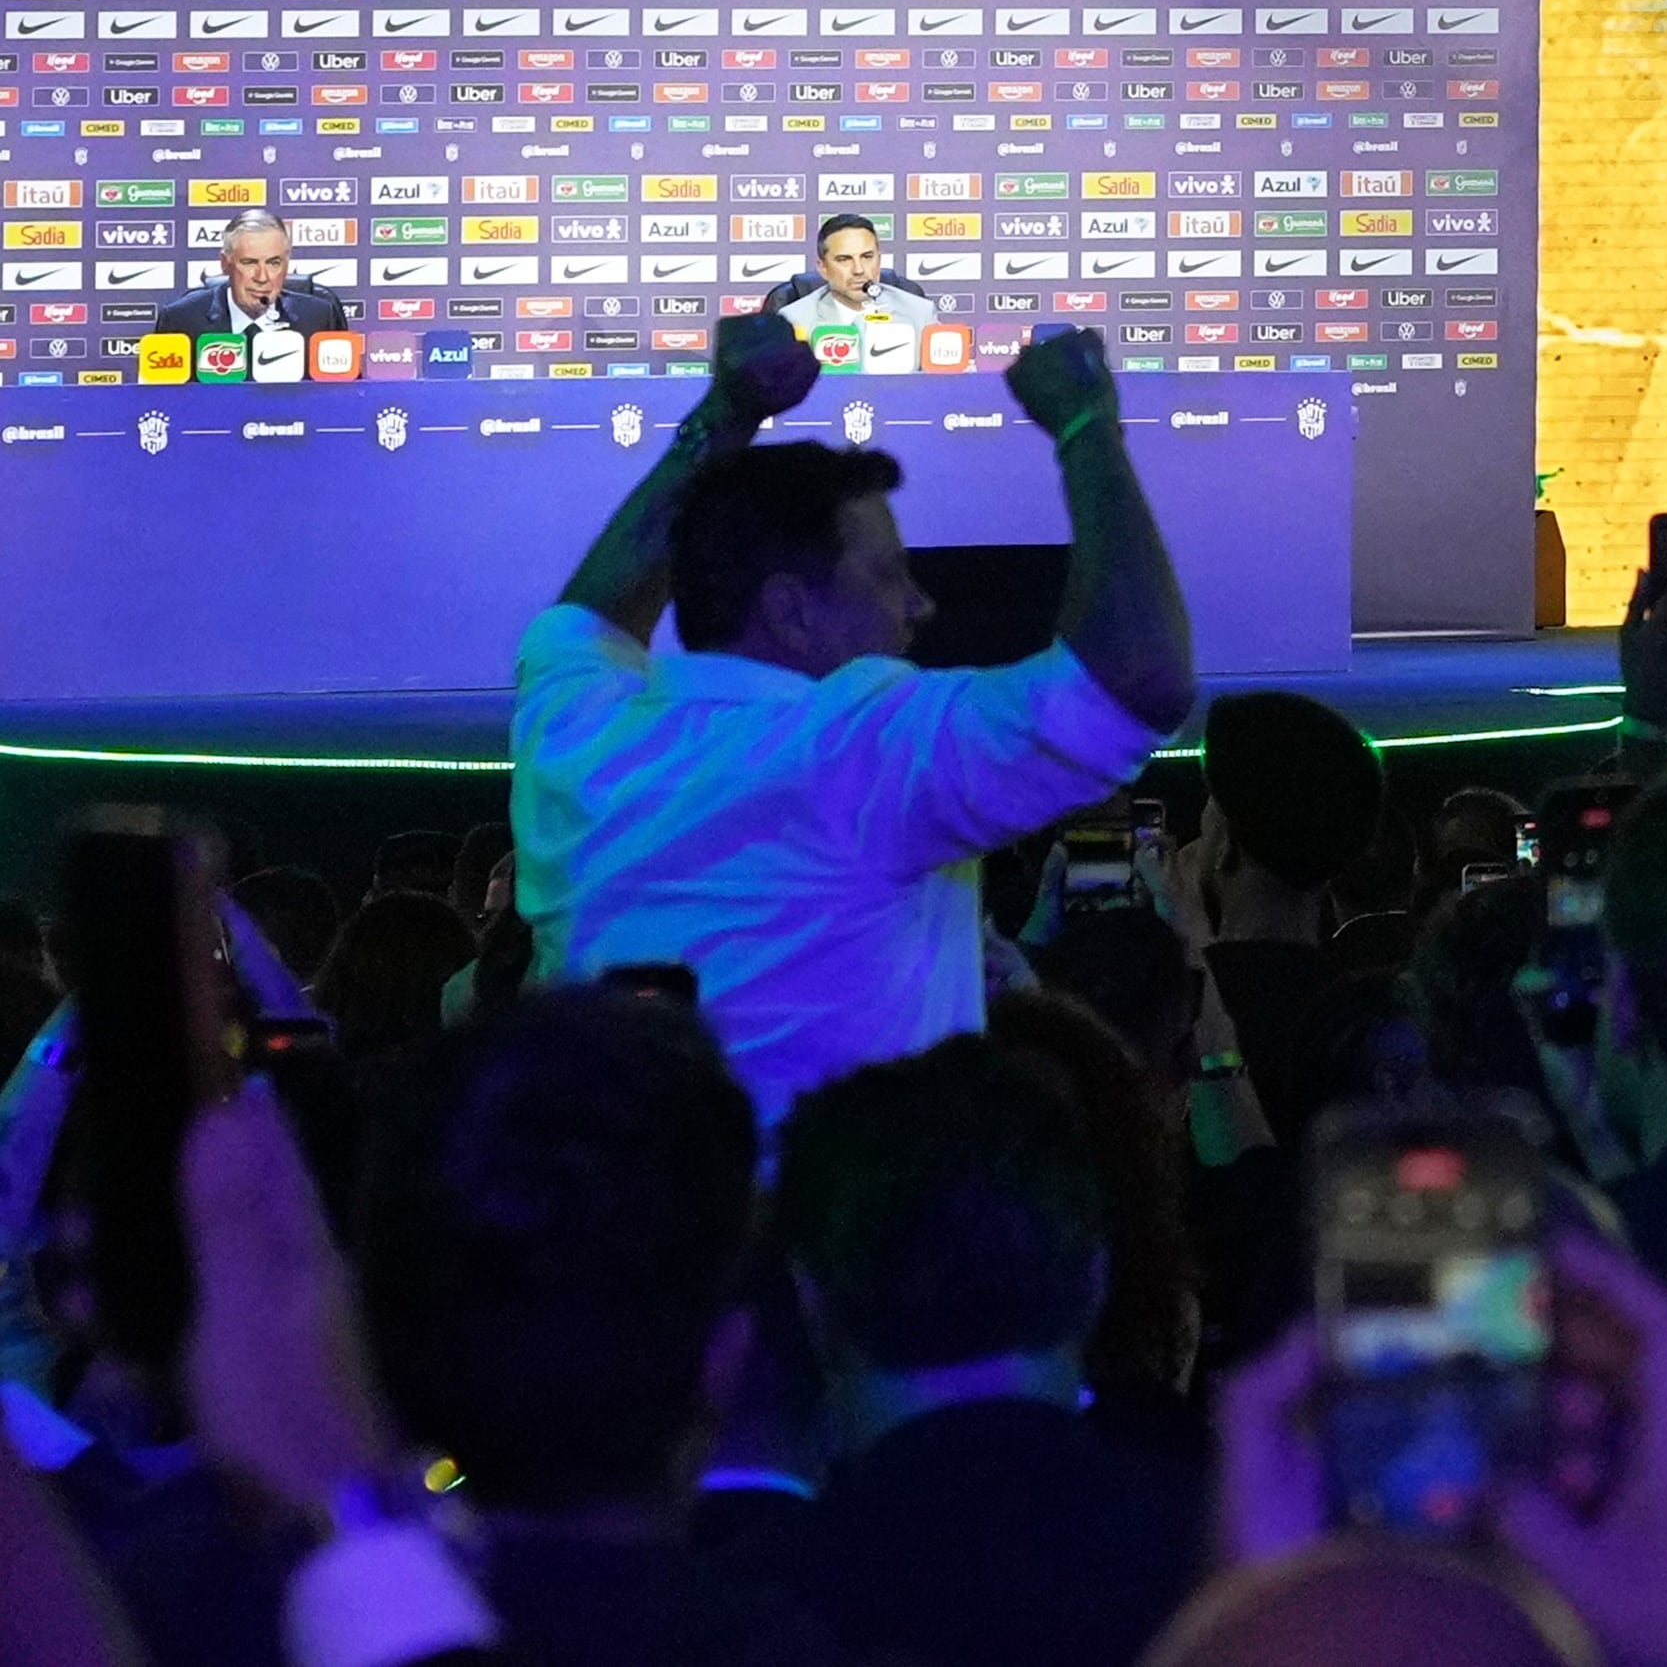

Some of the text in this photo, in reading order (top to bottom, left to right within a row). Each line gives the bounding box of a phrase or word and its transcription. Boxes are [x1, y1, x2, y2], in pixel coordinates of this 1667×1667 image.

[320, 54, 360, 69] Uber
[661, 53, 700, 66] Uber
[996, 51, 1035, 66] Uber
[1389, 51, 1427, 65] Uber
[110, 90, 151, 104] Uber
[457, 86, 496, 101] Uber
[796, 86, 835, 100] Uber
[1128, 85, 1166, 99] Uber
[1259, 84, 1297, 98] Uber
[481, 182, 520, 198] itaú
[656, 177, 701, 196] Sadia
[737, 179, 781, 197] vivo
[826, 181, 866, 195] Azul
[925, 179, 963, 195] itaú
[1097, 174, 1139, 193] Sadia
[1175, 176, 1218, 193] vivo
[1262, 178, 1300, 192] Azul
[1358, 176, 1395, 192] itaú
[23, 186, 63, 204] itaú
[204, 183, 248, 202] Sadia
[287, 183, 333, 201] vivo
[379, 184, 420, 199] Azul
[477, 219, 522, 238] Sadia
[559, 220, 604, 238] vivo
[649, 222, 689, 236] Azul
[749, 220, 787, 237] itaú
[922, 217, 966, 234] Sadia
[1001, 217, 1045, 235] vivo
[1089, 219, 1128, 233] Azul
[1186, 216, 1224, 233] itaú
[1355, 212, 1397, 232] Sadia
[1433, 214, 1474, 231] vivo
[20, 224, 65, 244] Sadia
[103, 226, 149, 243] vivo
[299, 224, 338, 241] itaú
[660, 299, 699, 313] Uber
[994, 295, 1034, 310] Uber
[1388, 292, 1425, 306] Uber
[1126, 327, 1165, 342] Uber
[1257, 326, 1296, 340] Uber
[108, 341, 139, 355] Ube
[429, 348, 468, 362] Azul
[979, 342, 1009, 355] vivo
[147, 350, 184, 370] Sadia
[370, 349, 401, 363] vivo
